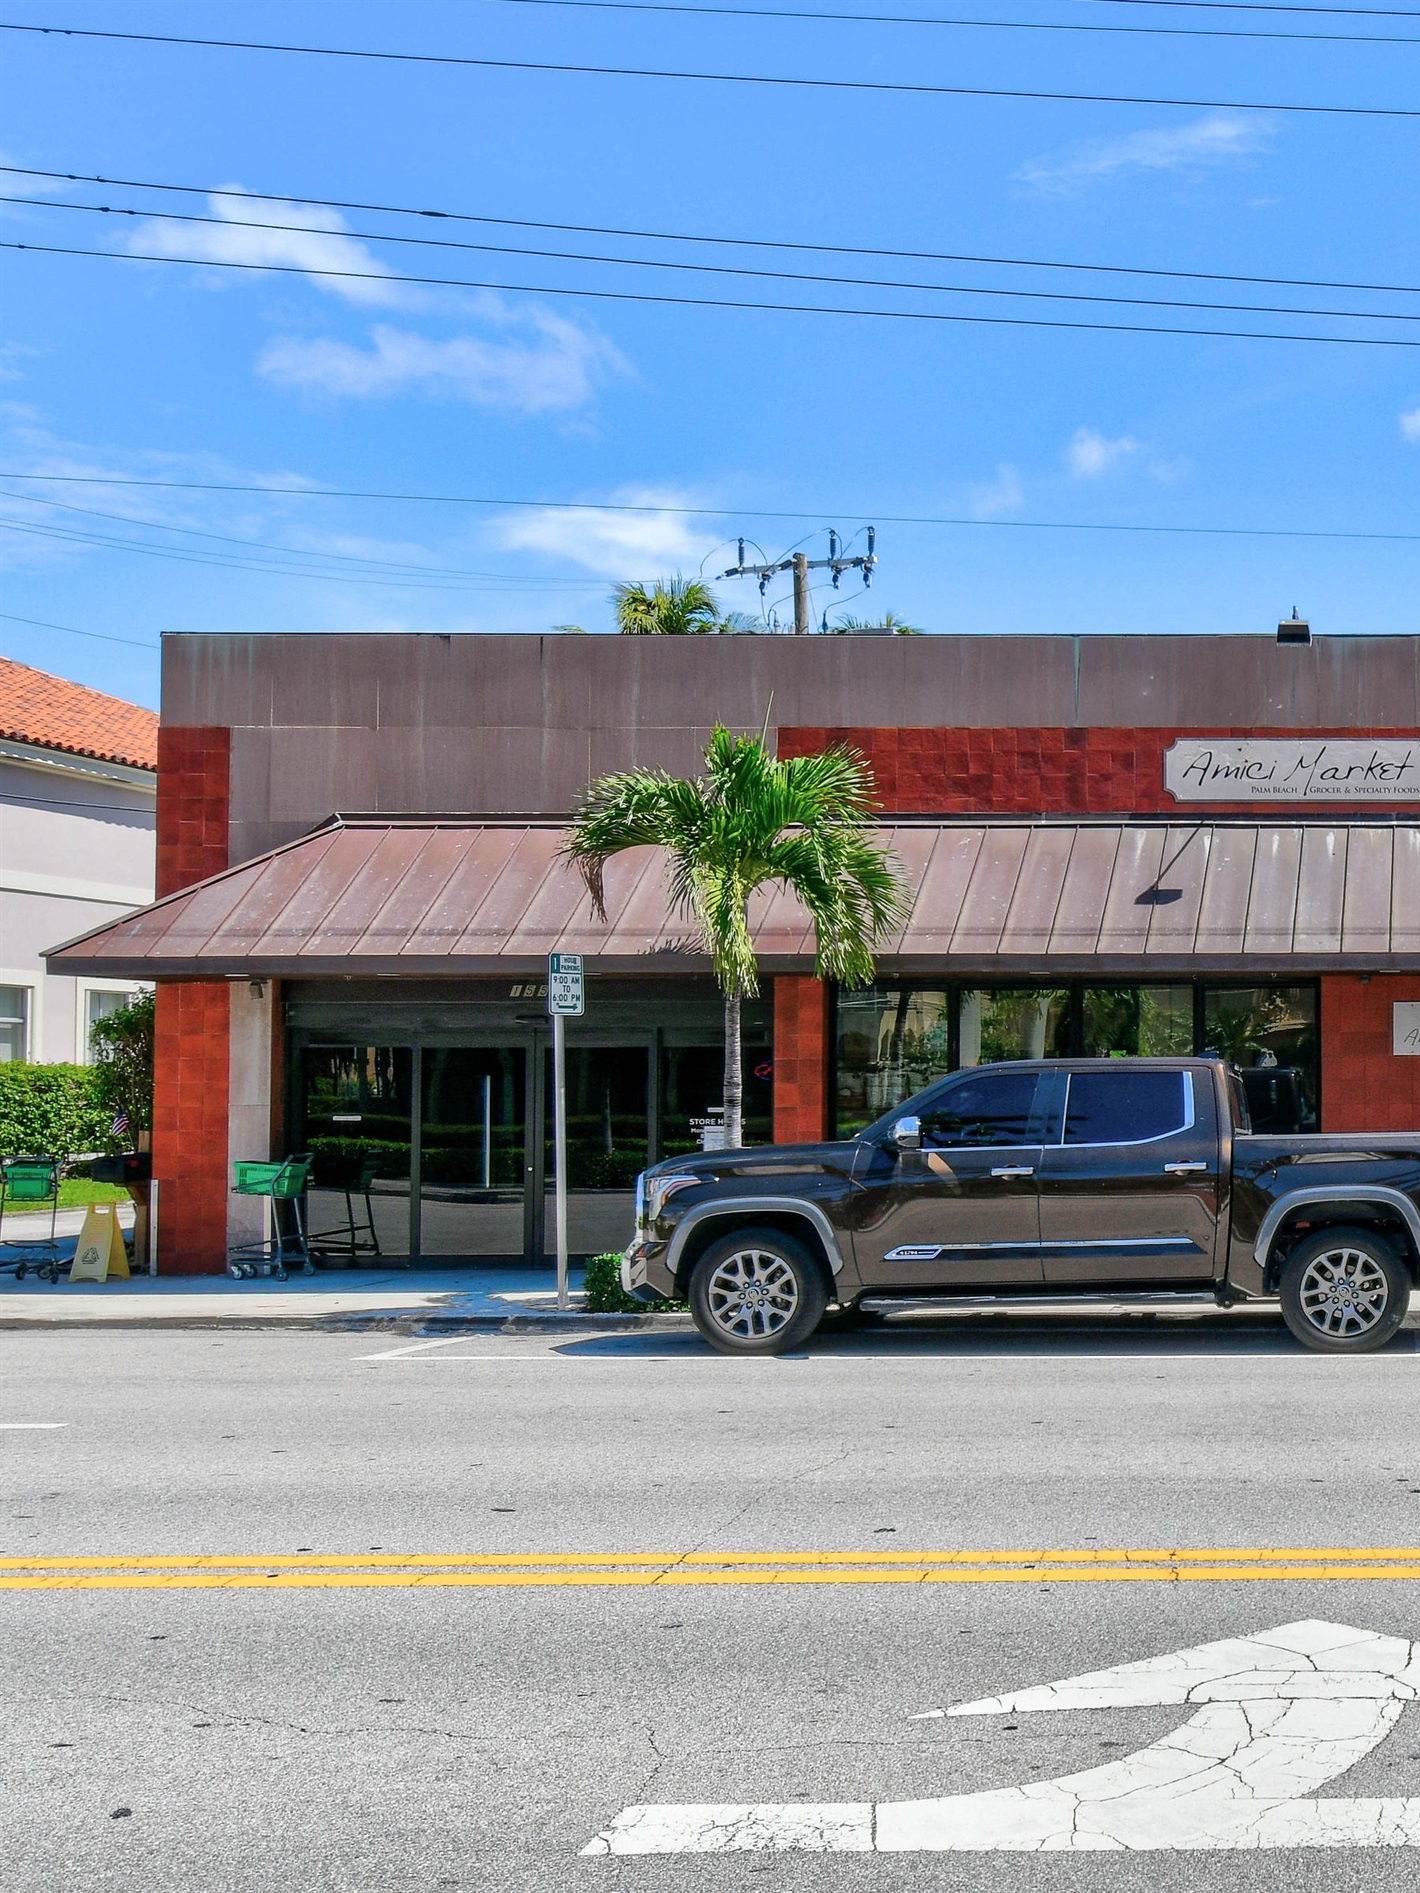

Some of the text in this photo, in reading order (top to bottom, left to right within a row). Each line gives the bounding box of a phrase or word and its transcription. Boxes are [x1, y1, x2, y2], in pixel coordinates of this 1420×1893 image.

[1182, 746, 1415, 796] Amici Market
[1251, 786, 1420, 794] PALM BEACH GROCER & SPECIALTY FOODS
[553, 975, 580, 985] 9:00 AM
[562, 985, 571, 993] TO
[552, 993, 581, 1002] 6:00 PM
